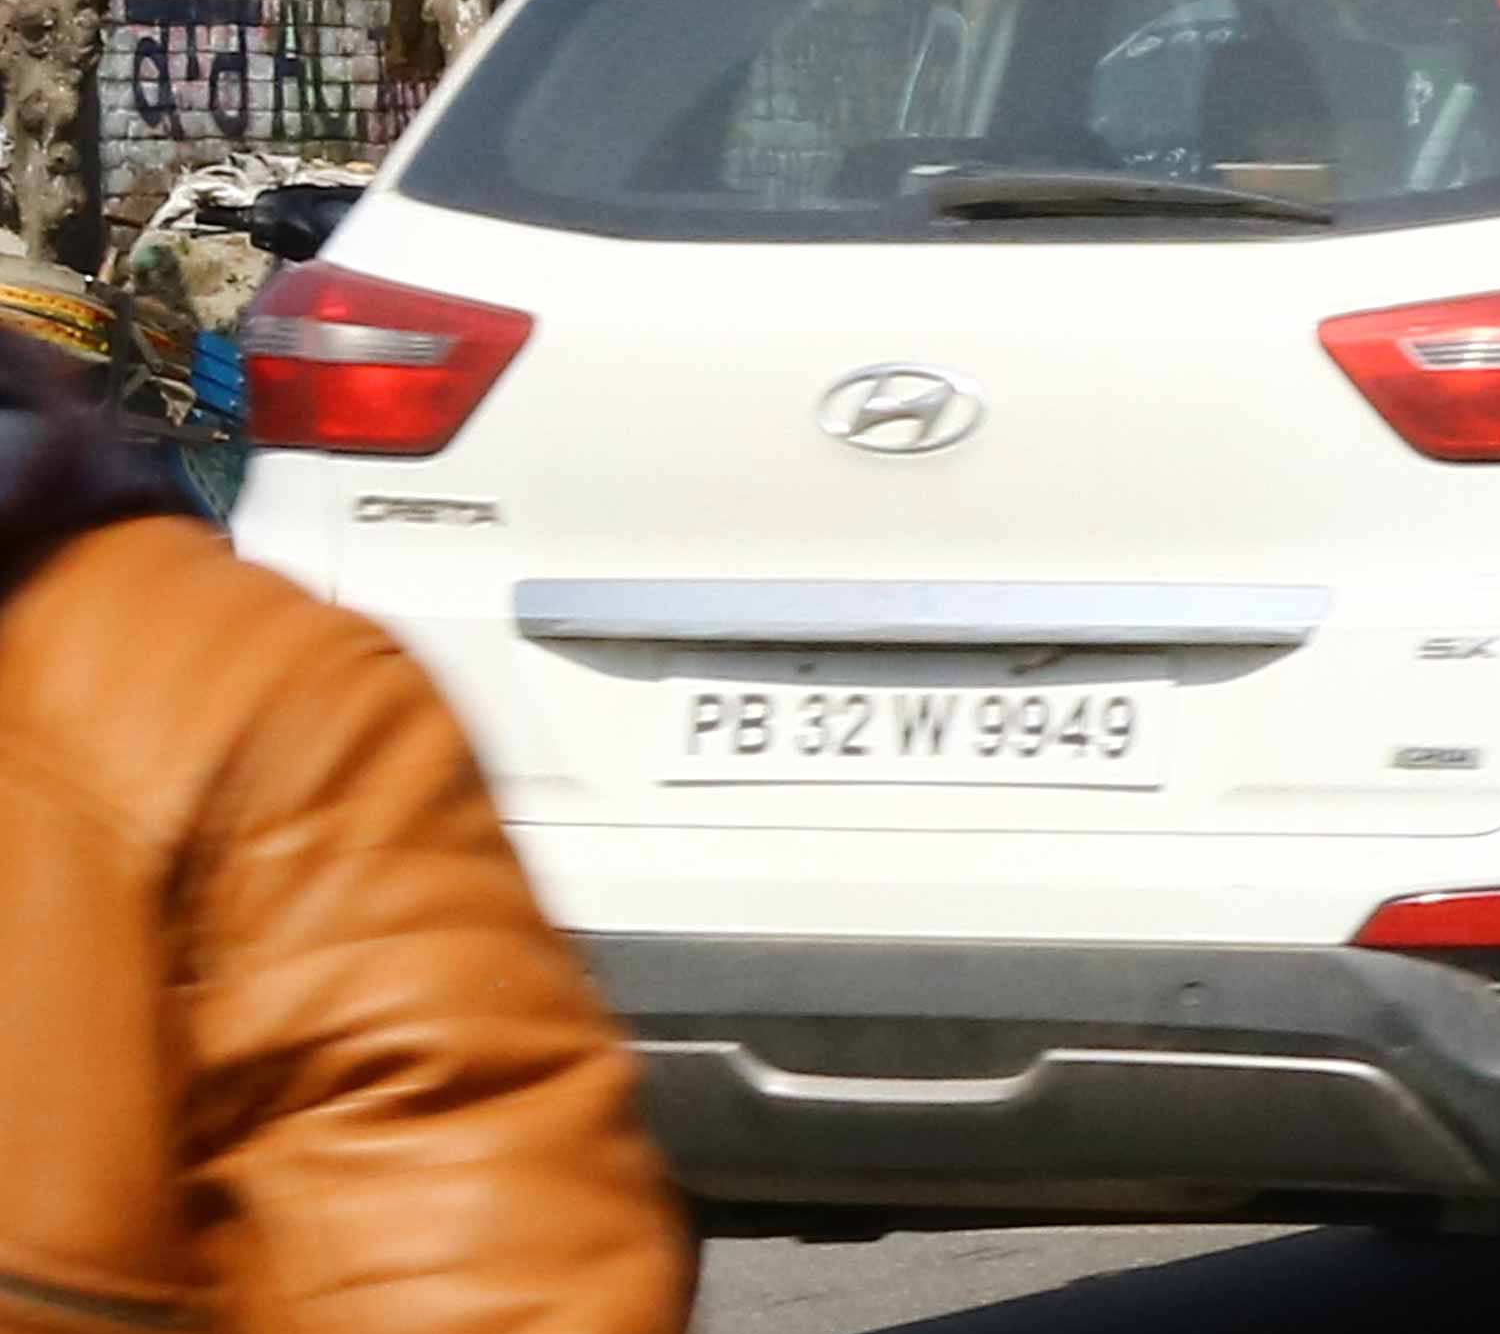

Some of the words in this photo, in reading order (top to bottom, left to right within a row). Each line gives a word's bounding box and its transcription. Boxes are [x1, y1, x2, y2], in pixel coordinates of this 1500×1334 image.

[686, 692, 773, 757] PB
[797, 693, 872, 757] 32
[890, 693, 960, 757] W
[974, 694, 1137, 759] 9949
